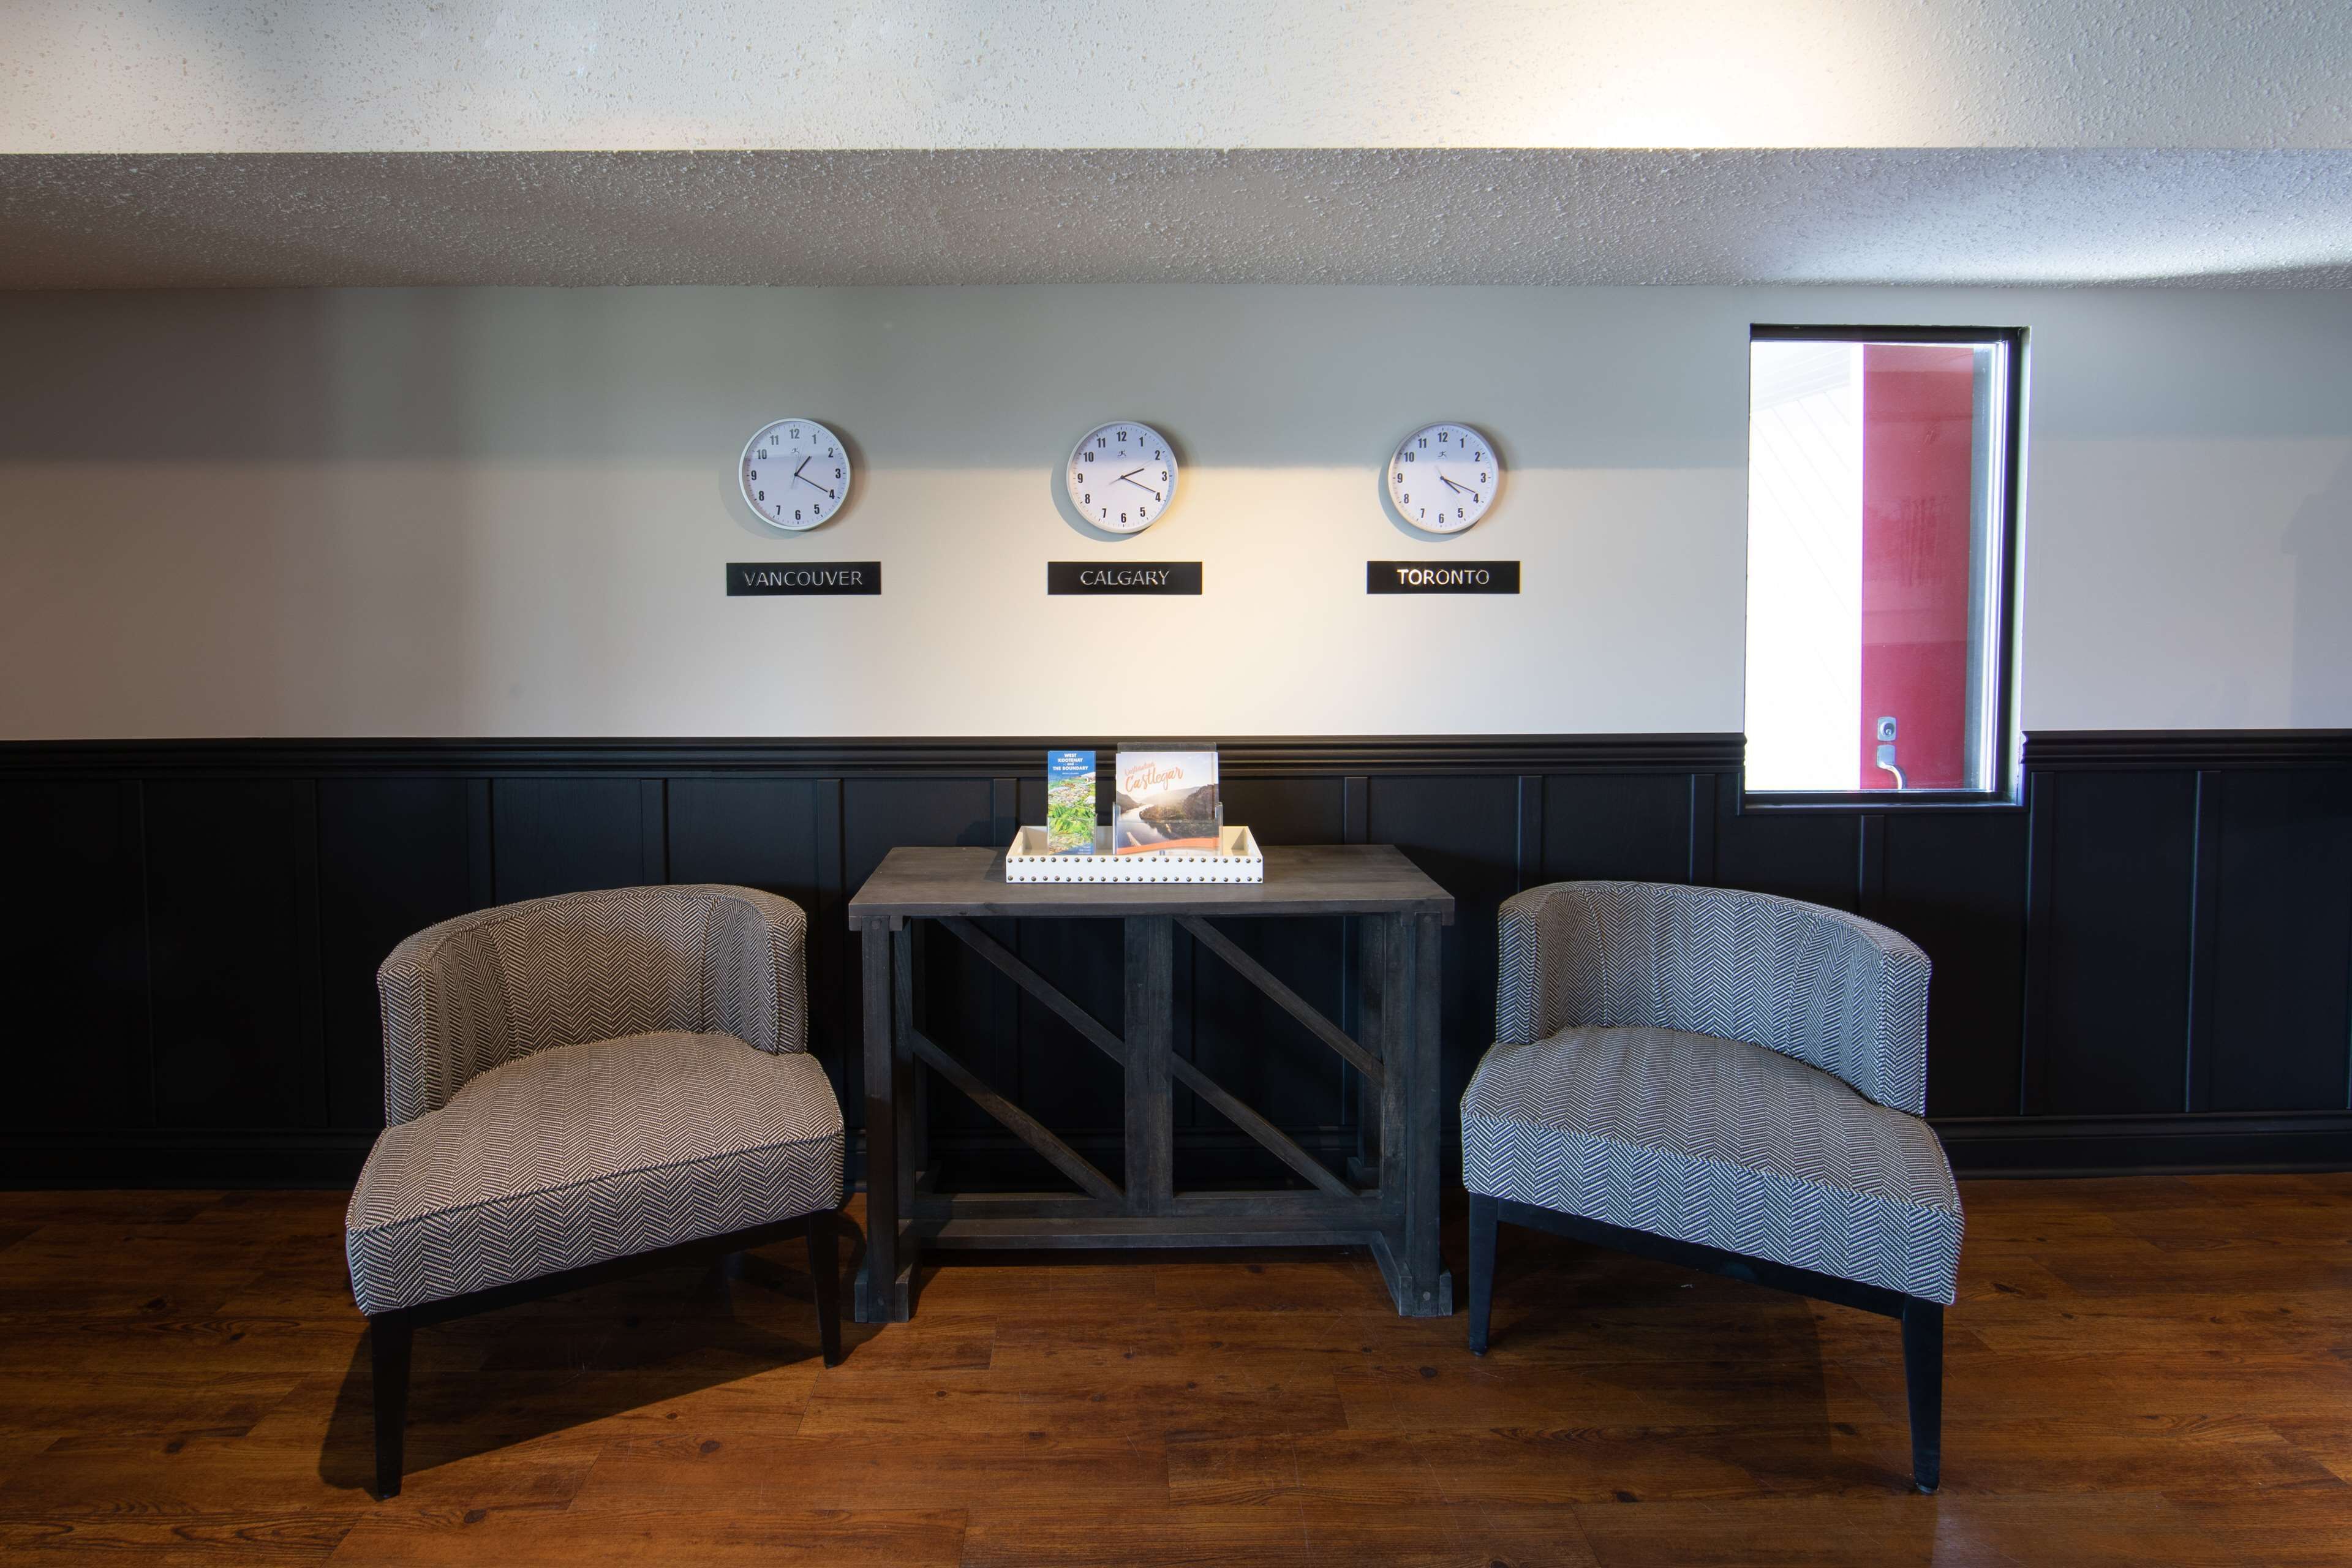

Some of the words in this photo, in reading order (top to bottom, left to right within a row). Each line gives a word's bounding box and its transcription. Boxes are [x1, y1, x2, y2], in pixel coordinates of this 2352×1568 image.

[789, 428, 800, 439] 12
[1116, 431, 1127, 442] 12
[1438, 432, 1448, 443] 12
[769, 434, 779, 446] 11
[812, 434, 816, 445] 1
[1096, 437, 1106, 448] 11
[1139, 436, 1144, 447] 1
[1417, 437, 1427, 448] 11
[1460, 437, 1464, 448] 1
[756, 448, 767, 460] 10
[827, 447, 834, 458] 2
[1083, 451, 1094, 462] 10
[1155, 450, 1161, 461] 2
[1403, 451, 1415, 462] 10
[1474, 451, 1480, 462] 2
[751, 470, 757, 481] 9
[835, 468, 841, 479] 3
[1077, 473, 1084, 484] 9
[1161, 471, 1167, 481] 3
[1397, 472, 1403, 483] 9
[1480, 472, 1487, 483] 3
[758, 491, 765, 501] 8
[829, 489, 835, 500] 4
[1085, 493, 1091, 504] 8
[1155, 492, 1161, 502] 4
[1403, 493, 1409, 504] 8
[1473, 493, 1479, 503] 4
[775, 505, 781, 516] 7
[813, 504, 820, 514] 5
[1102, 508, 1107, 518] 7
[1140, 507, 1146, 518] 5
[1420, 508, 1425, 518] 7
[1457, 508, 1463, 518] 5
[794, 510, 801, 521] 6
[1121, 513, 1127, 523] 6
[1438, 513, 1444, 524] 6
[743, 571, 863, 586] VANCOUVER
[1080, 570, 1169, 585] CALGARY
[1396, 569, 1489, 585] TORONTO
[1126, 767, 1183, 792] Castlegar
